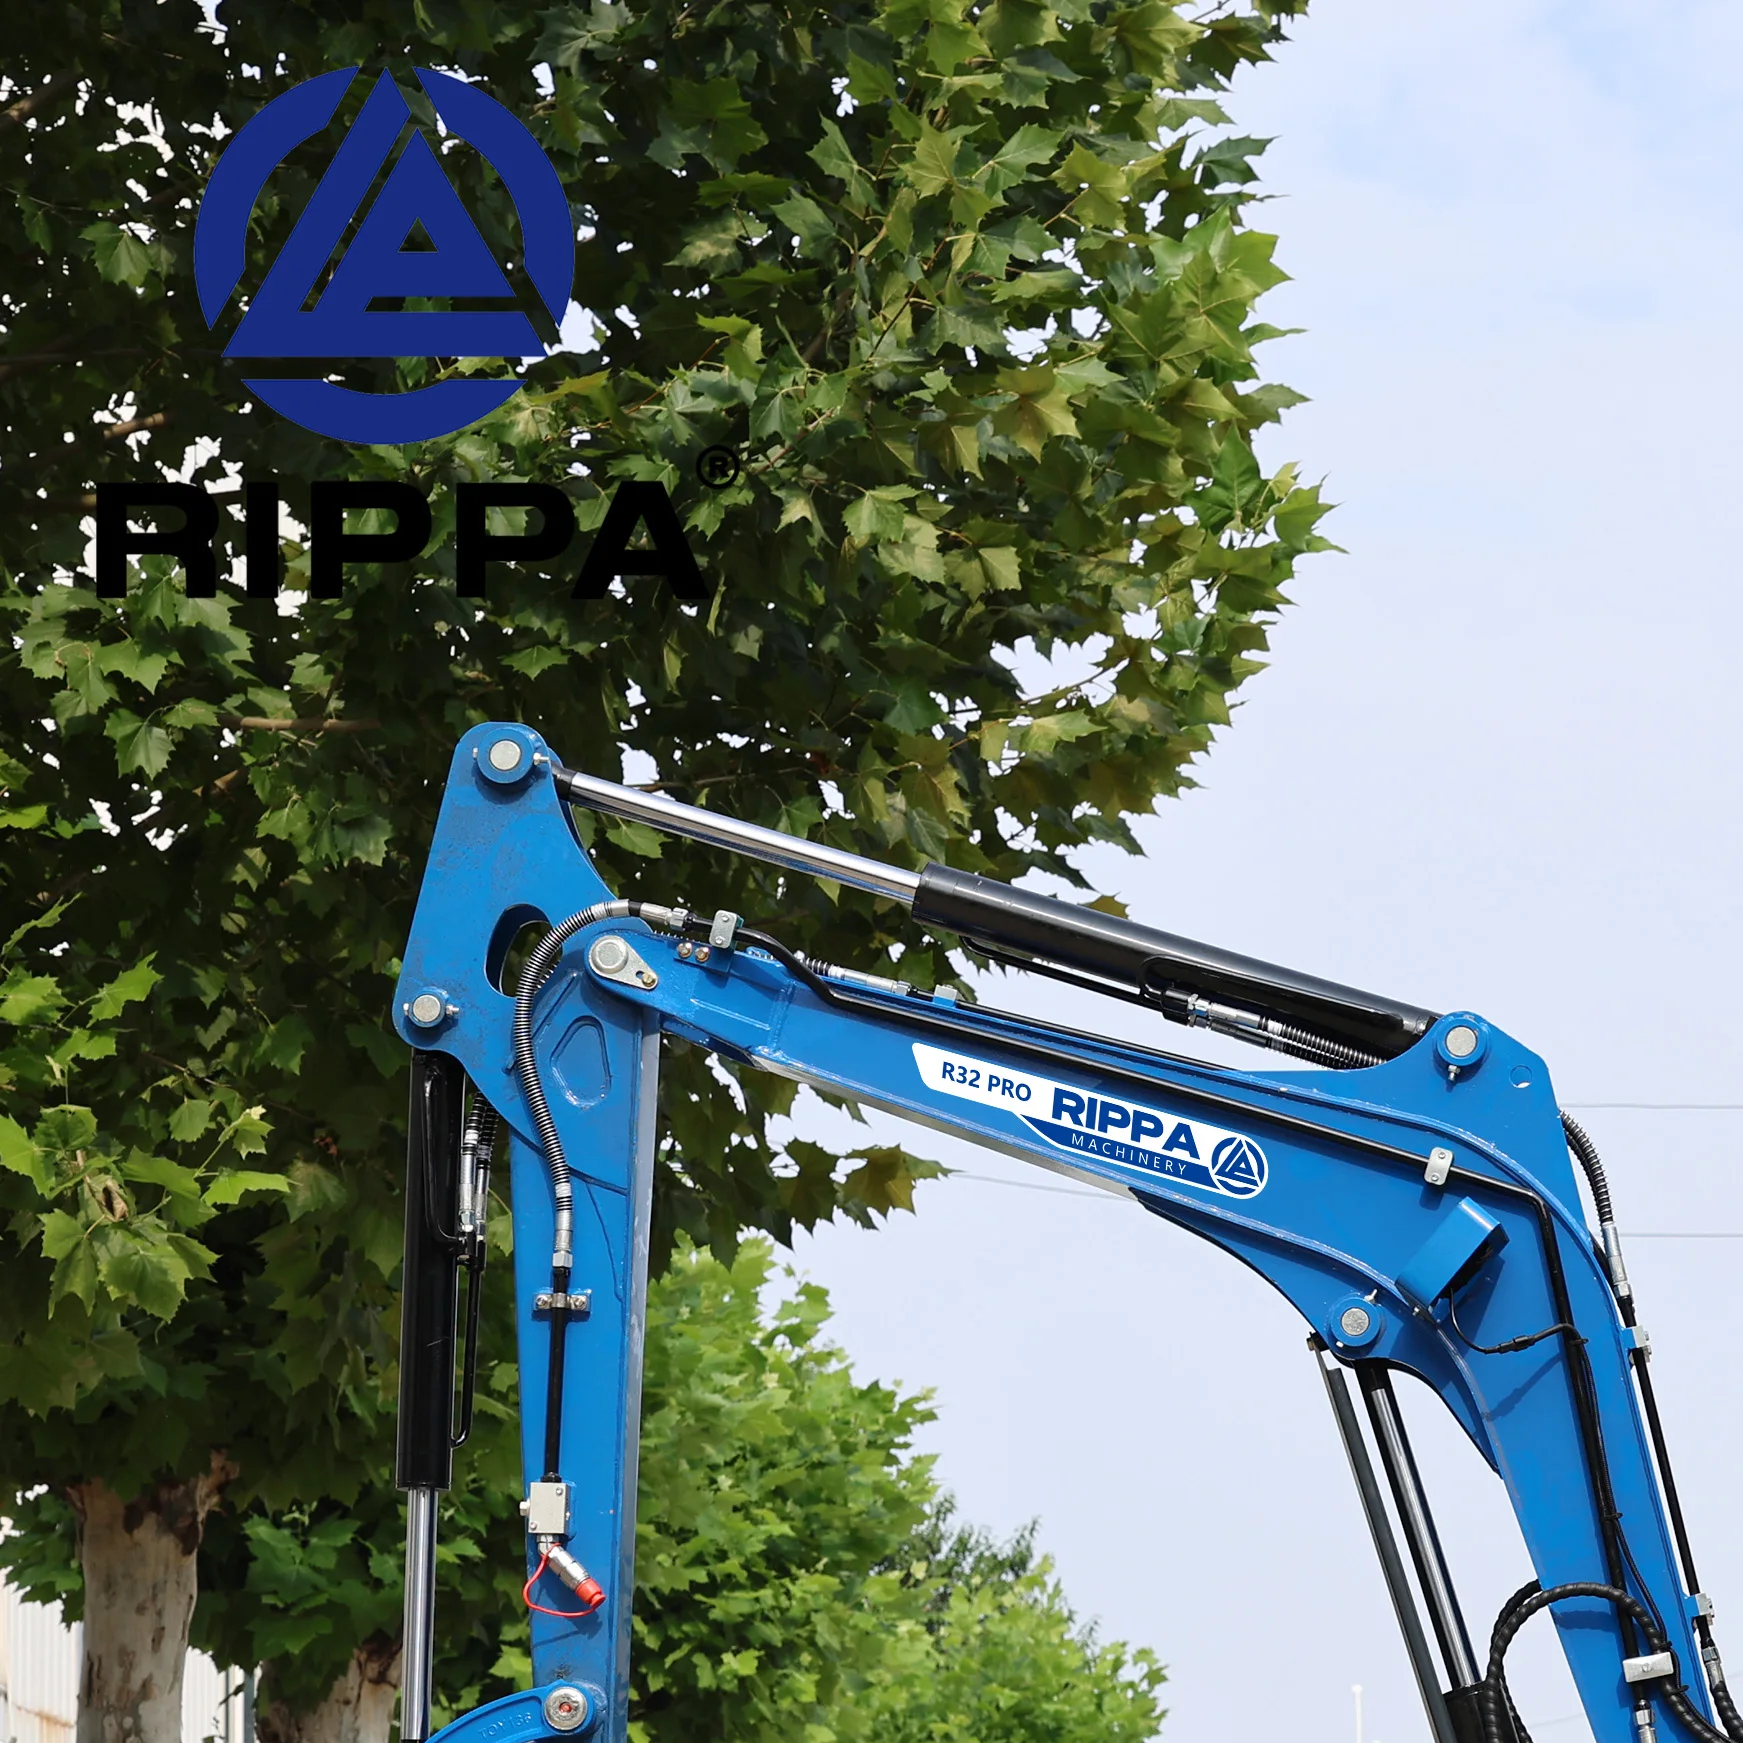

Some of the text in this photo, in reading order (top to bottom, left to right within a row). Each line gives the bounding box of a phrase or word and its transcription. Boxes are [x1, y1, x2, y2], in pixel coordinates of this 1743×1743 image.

[941, 1061, 1032, 1102] R32 PRO
[1052, 1087, 1200, 1160] RIPPA
[1071, 1132, 1187, 1176] MACHINERY
